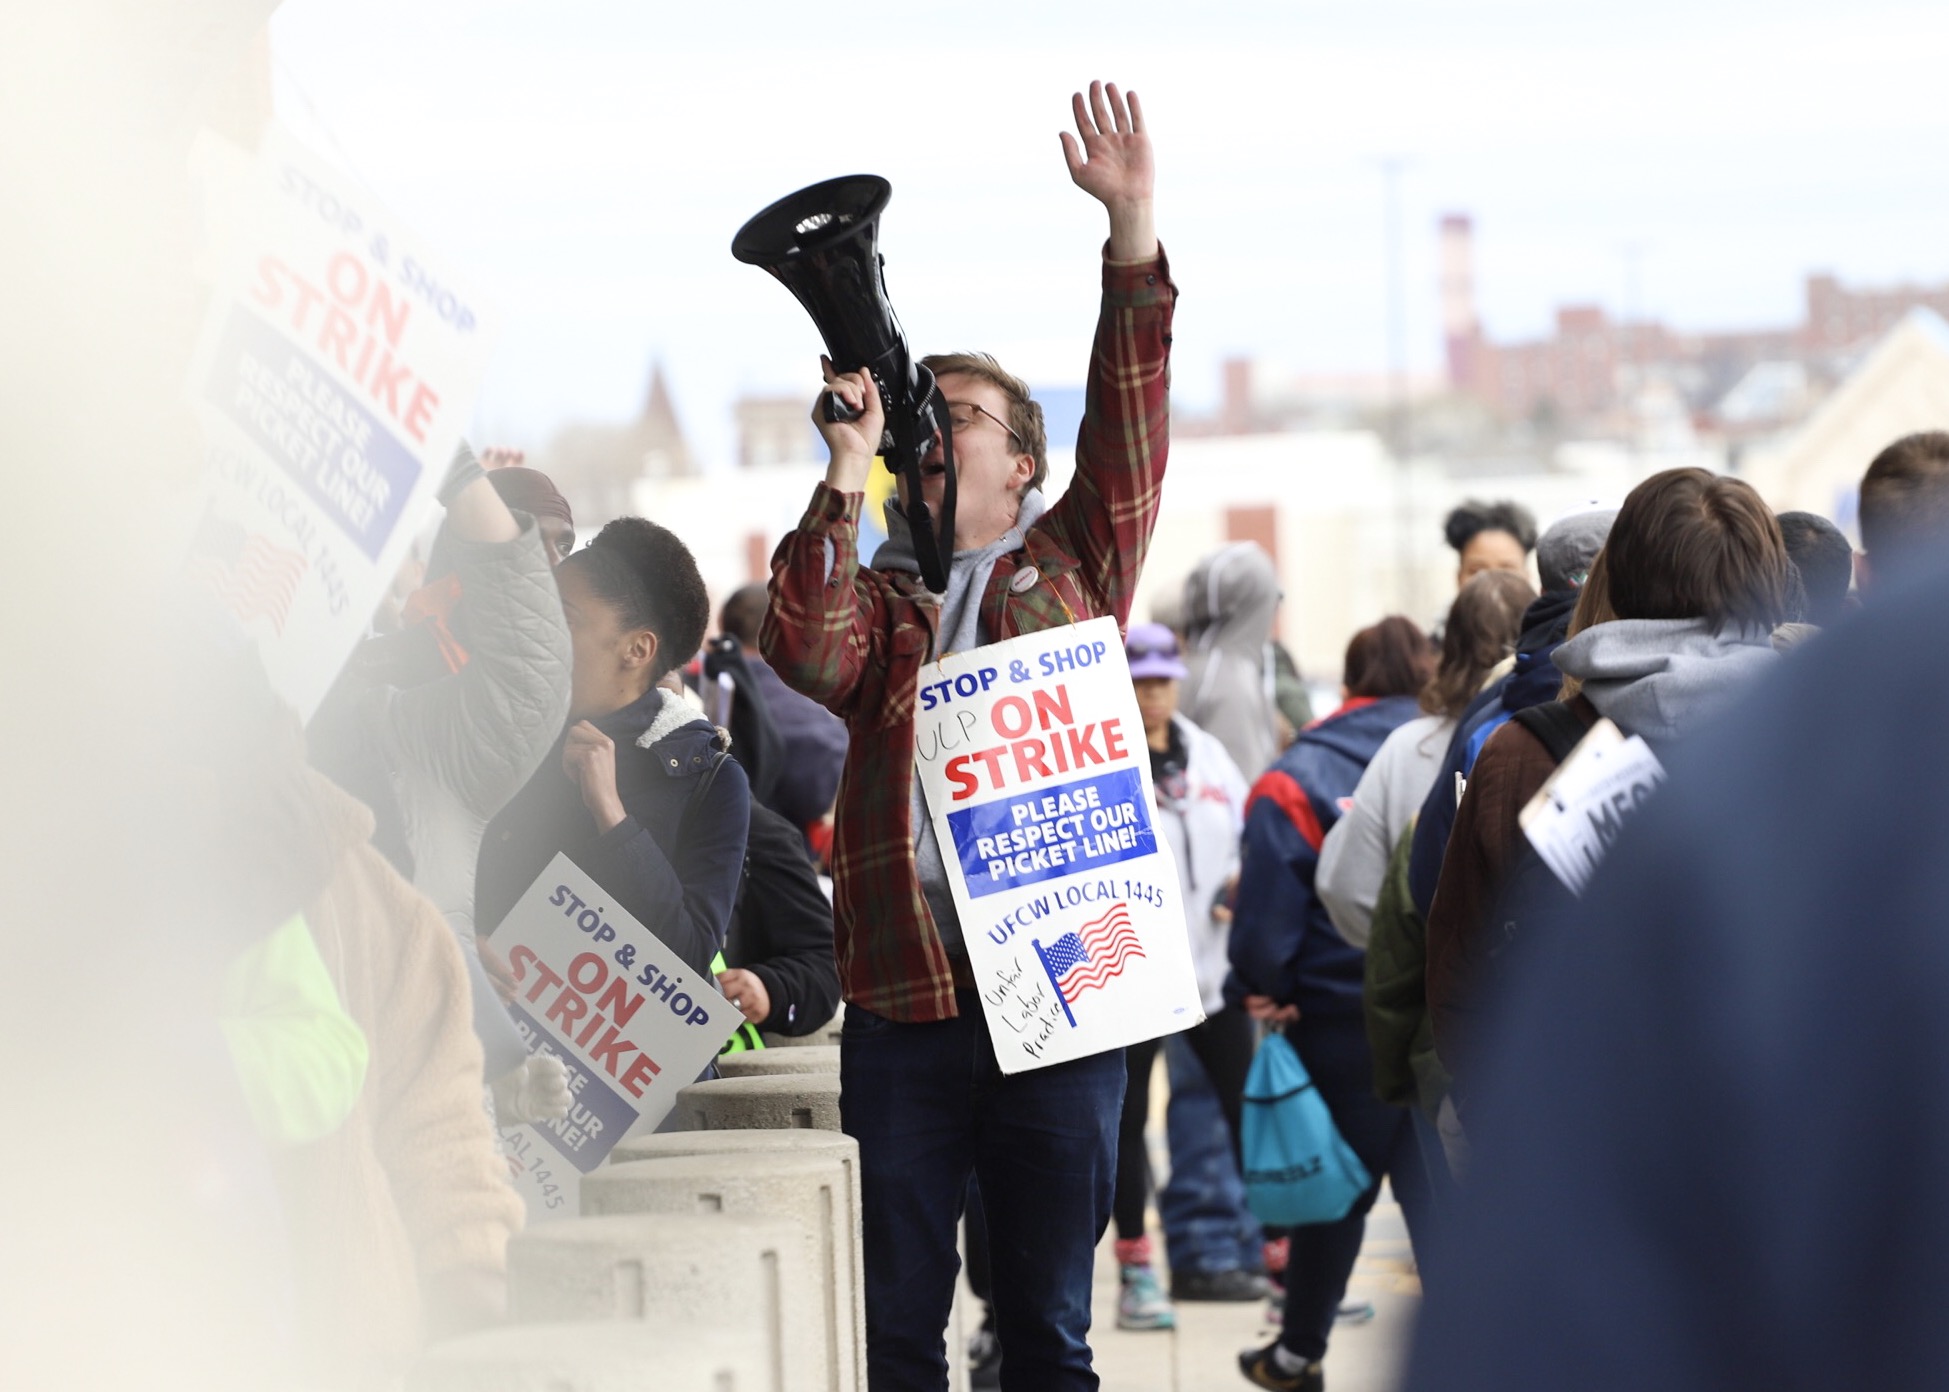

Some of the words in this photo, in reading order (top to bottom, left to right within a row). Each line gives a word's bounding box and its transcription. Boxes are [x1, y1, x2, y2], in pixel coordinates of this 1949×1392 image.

[279, 162, 364, 235] STOP
[369, 231, 390, 268] &
[399, 255, 478, 334] SHOP
[326, 250, 411, 349] ON
[250, 254, 442, 445] STRIKE
[286, 356, 373, 450] PLEASE
[341, 447, 392, 513] OUR
[920, 667, 998, 711] STOP
[1009, 659, 1032, 684] &
[1038, 641, 1106, 677] SHOP
[916, 710, 977, 762] ULP
[991, 684, 1074, 740] ON
[944, 718, 1129, 801] STRIKE
[976, 814, 1084, 860] RESPECT
[1090, 802, 1138, 831] OUR
[1011, 786, 1101, 826] PLEASE
[988, 840, 1077, 881] PICKET
[1083, 825, 1138, 858] LINE!
[987, 896, 1050, 945] UFCW
[1054, 880, 1119, 909] LOCAL
[1124, 880, 1164, 908] 1445
[549, 884, 616, 943] STOP
[614, 943, 637, 970] &
[636, 964, 709, 1026] SHOP
[985, 956, 1022, 1006] Unfair
[508, 944, 661, 1100] STRIKE
[567, 952, 646, 1028] ON
[1001, 981, 1045, 1033] Labor
[517, 1019, 589, 1095] PLESE
[541, 1117, 588, 1152] NE!
[567, 1098, 604, 1140] UR
[528, 1156, 565, 1210] 1445
